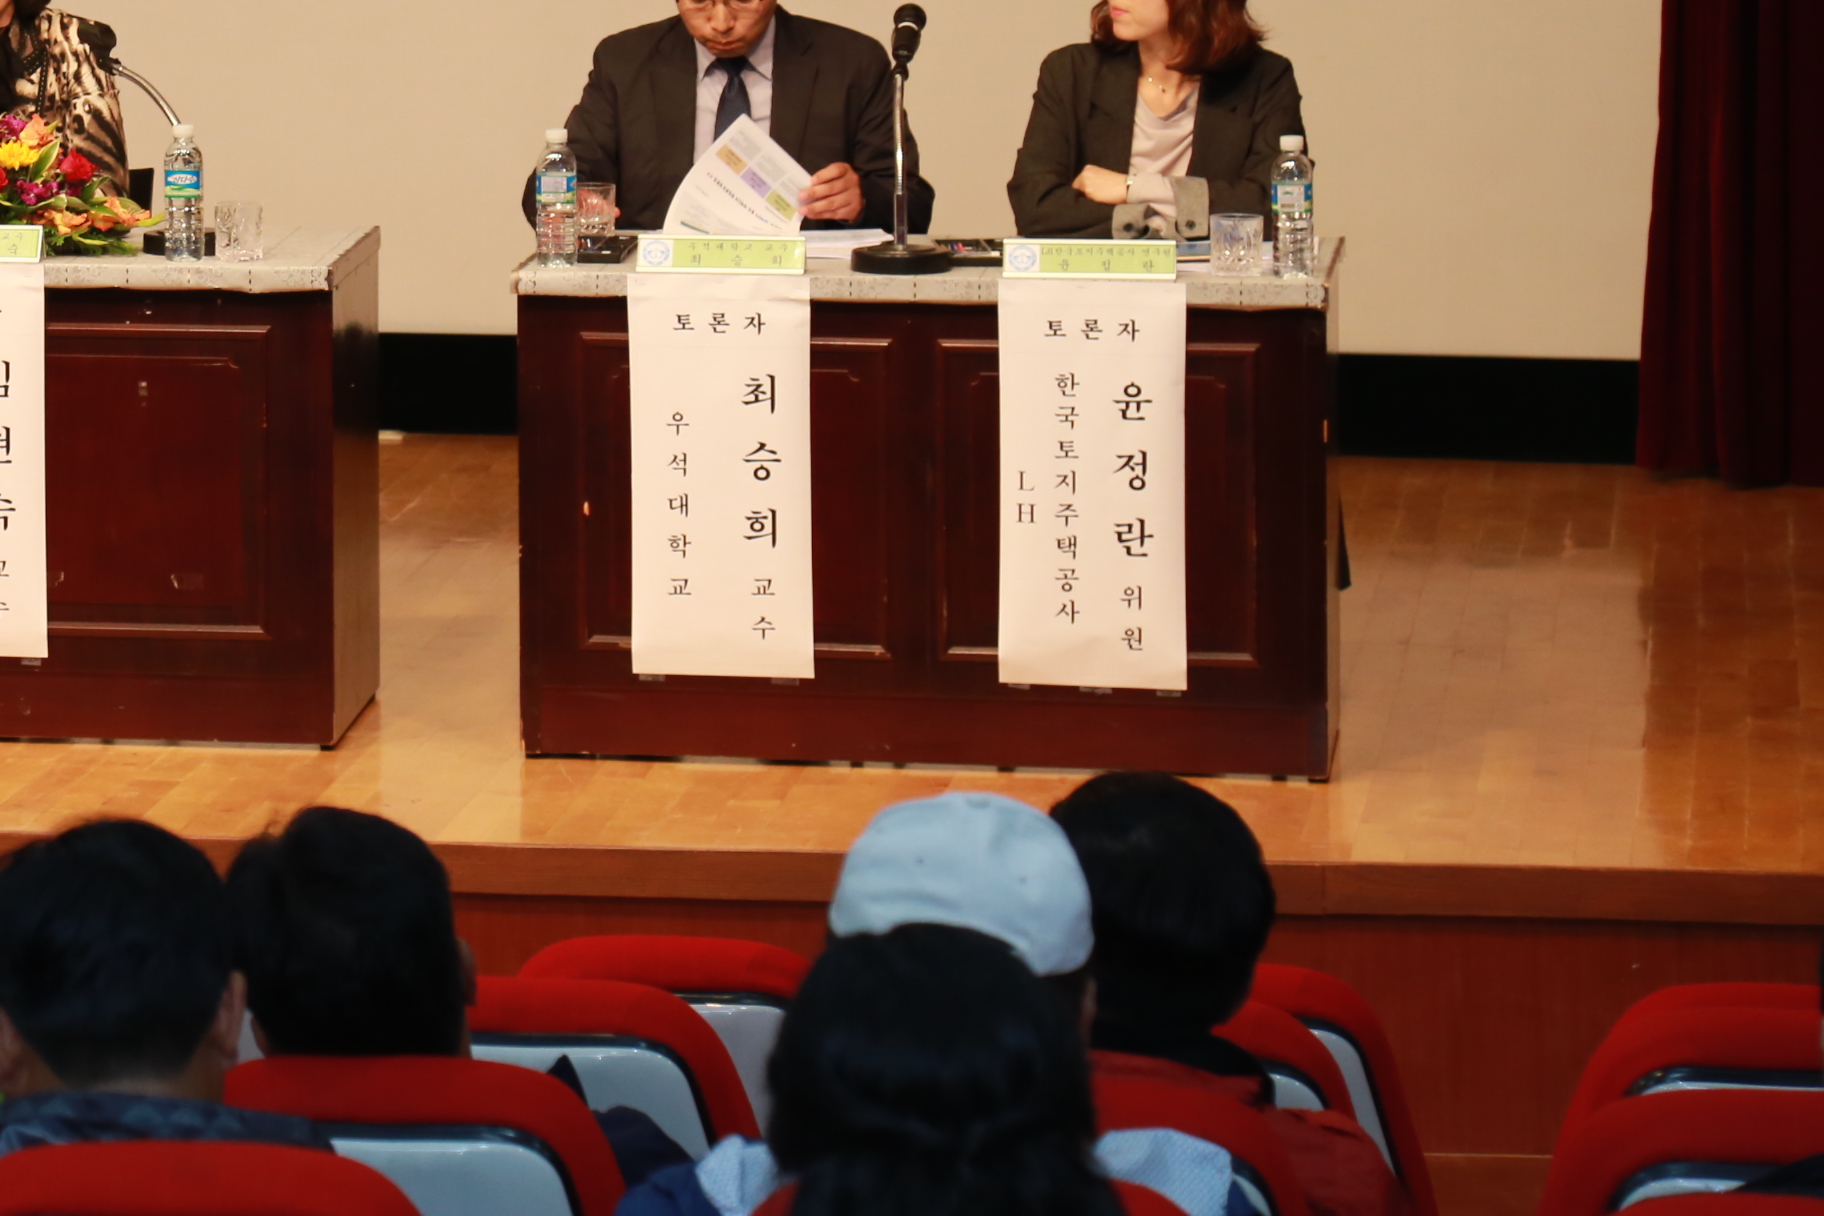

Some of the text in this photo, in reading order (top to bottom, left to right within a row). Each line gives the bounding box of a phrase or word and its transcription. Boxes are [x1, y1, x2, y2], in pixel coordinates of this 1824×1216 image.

[666, 411, 692, 596] 우석대학교
[742, 373, 782, 640] 최승희 교수
[1017, 470, 1035, 524] LH
[1055, 372, 1080, 625] 한국토지주택공사
[1113, 381, 1154, 651] 윤정란 위원
